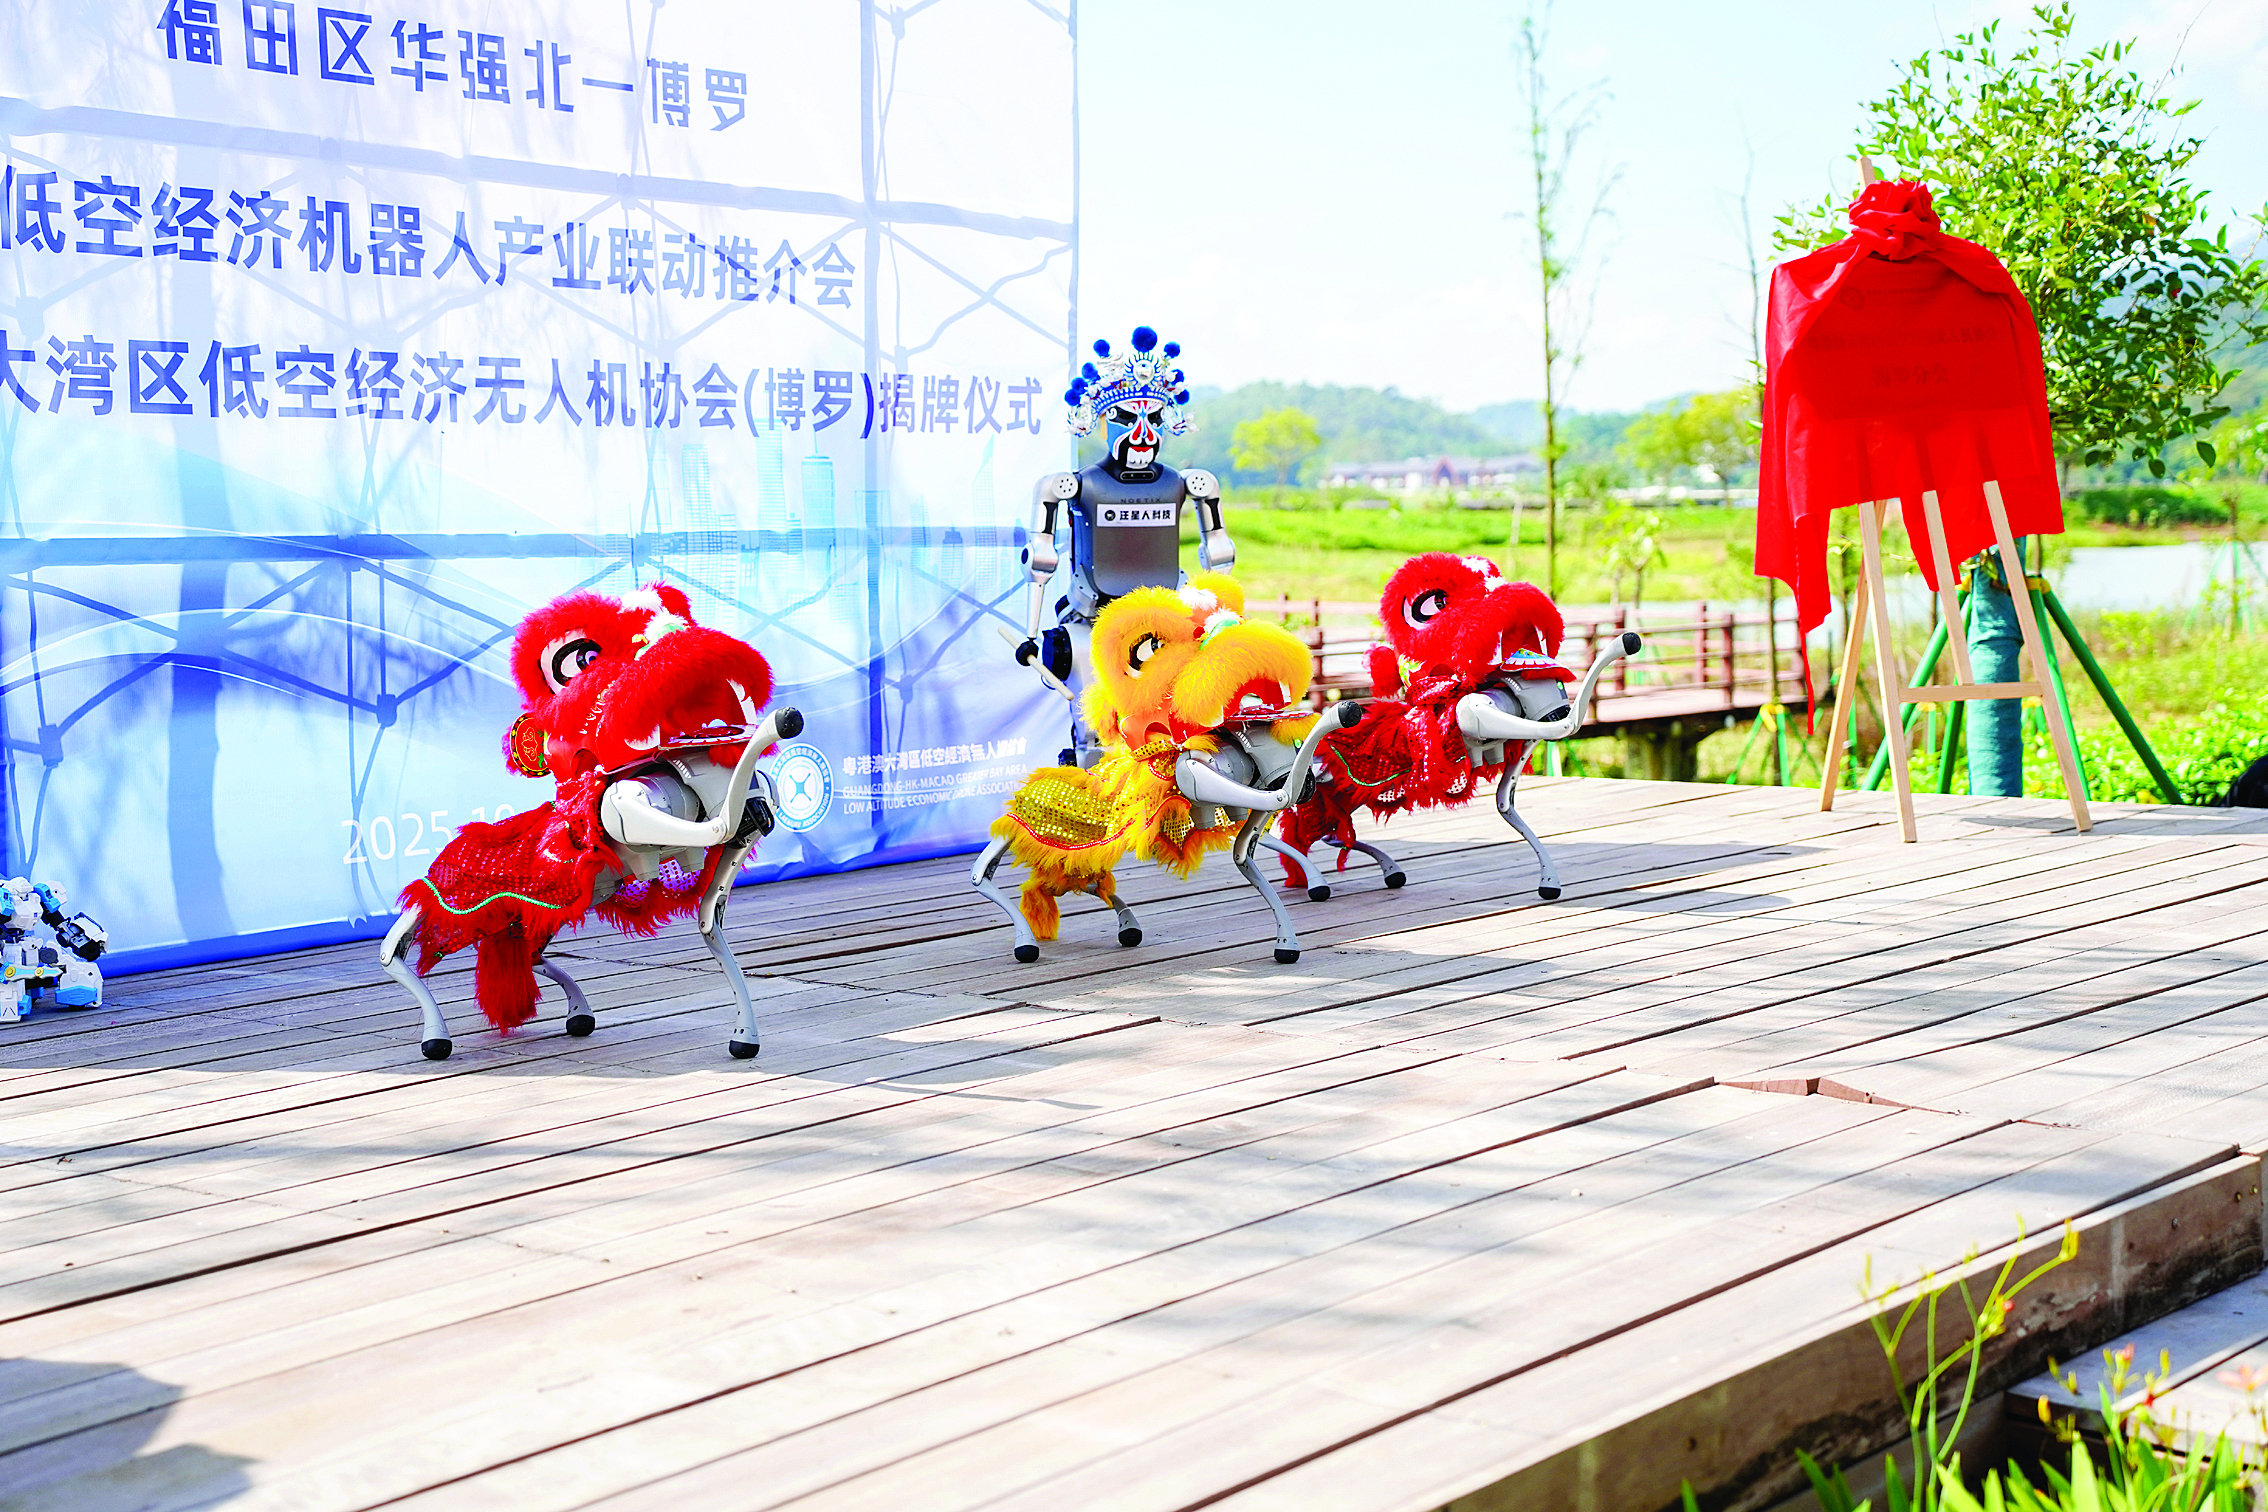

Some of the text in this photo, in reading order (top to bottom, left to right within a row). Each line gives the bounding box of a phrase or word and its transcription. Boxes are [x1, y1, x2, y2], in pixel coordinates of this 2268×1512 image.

[0, 164, 856, 309] 低空经济机器人产业联动推介会
[1119, 509, 1171, 520] 汪星人科技
[843, 764, 1028, 797] GUANGDONG-HK-MACAO GREATER BAY AREA
[844, 801, 865, 814] LOW
[865, 797, 906, 812] ALTITUDE
[977, 780, 1022, 796] ASSOCIATI
